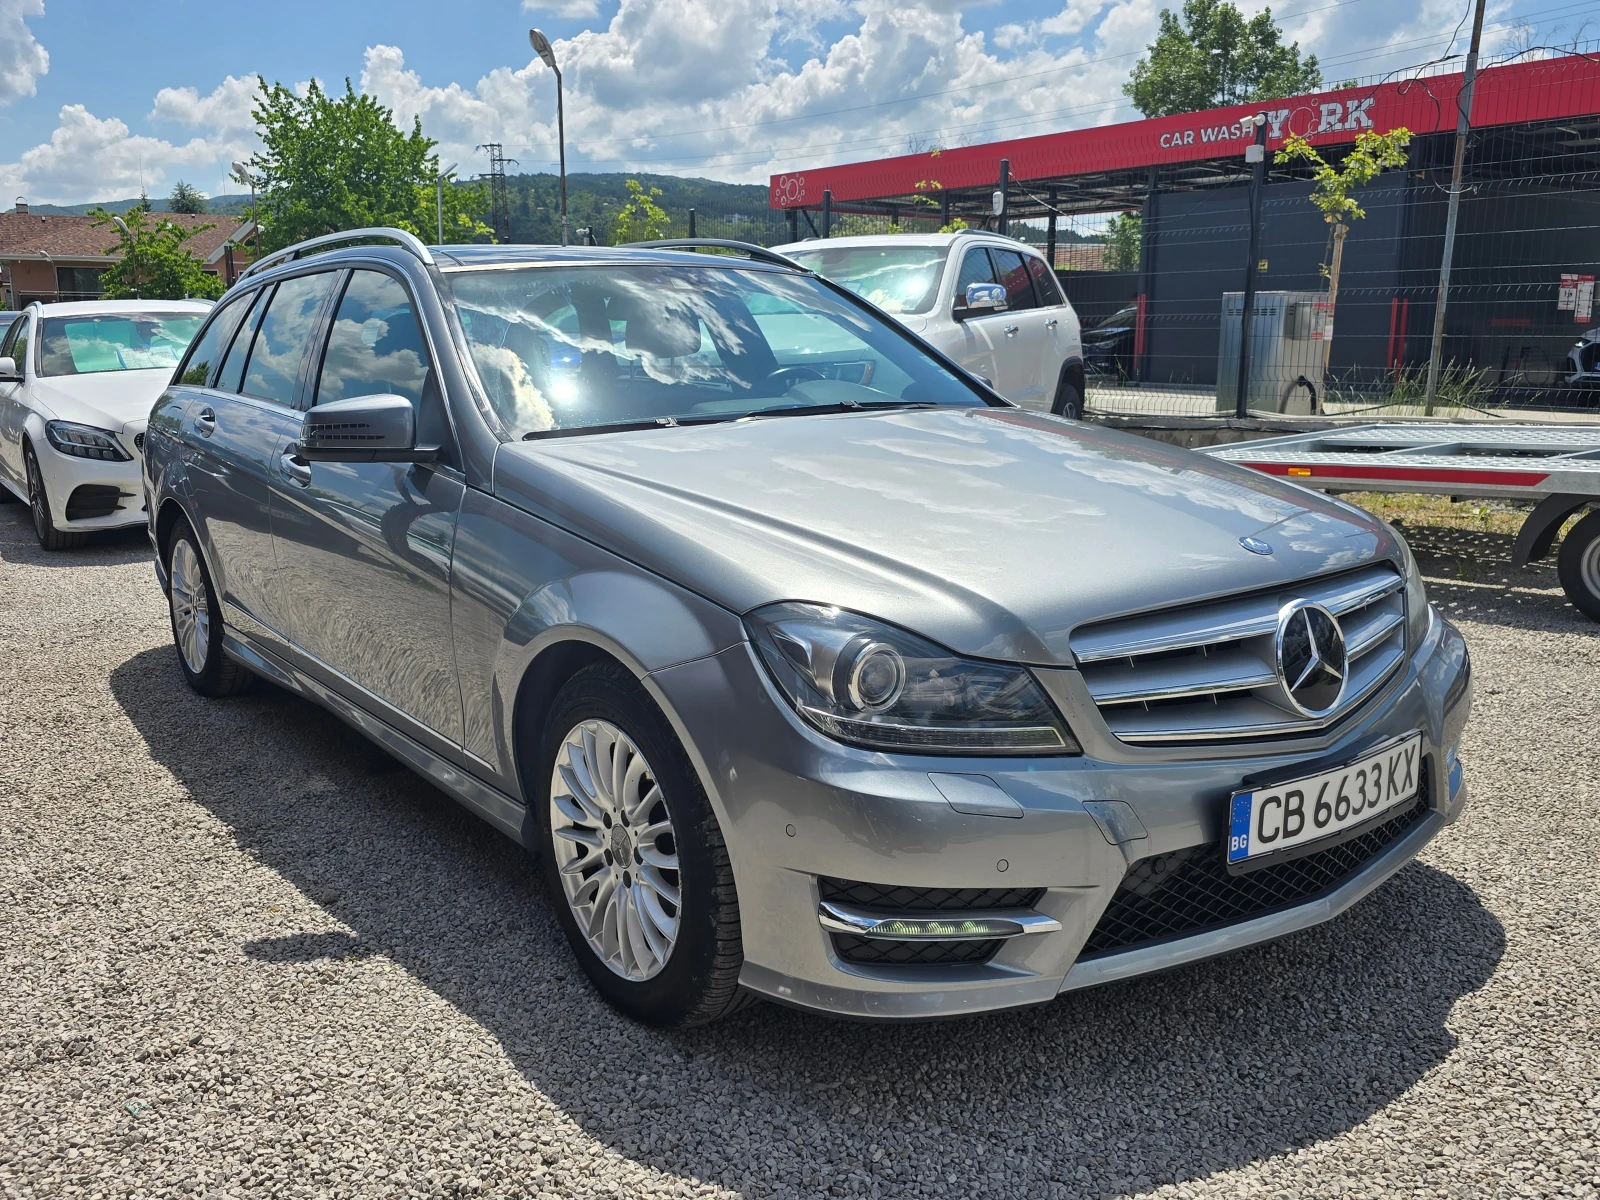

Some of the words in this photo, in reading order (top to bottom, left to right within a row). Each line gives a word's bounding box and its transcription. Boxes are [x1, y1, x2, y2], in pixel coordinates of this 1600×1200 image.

[1160, 130, 1195, 149] CAR
[1201, 123, 1254, 143] WASH
[1231, 834, 1248, 851] BG
